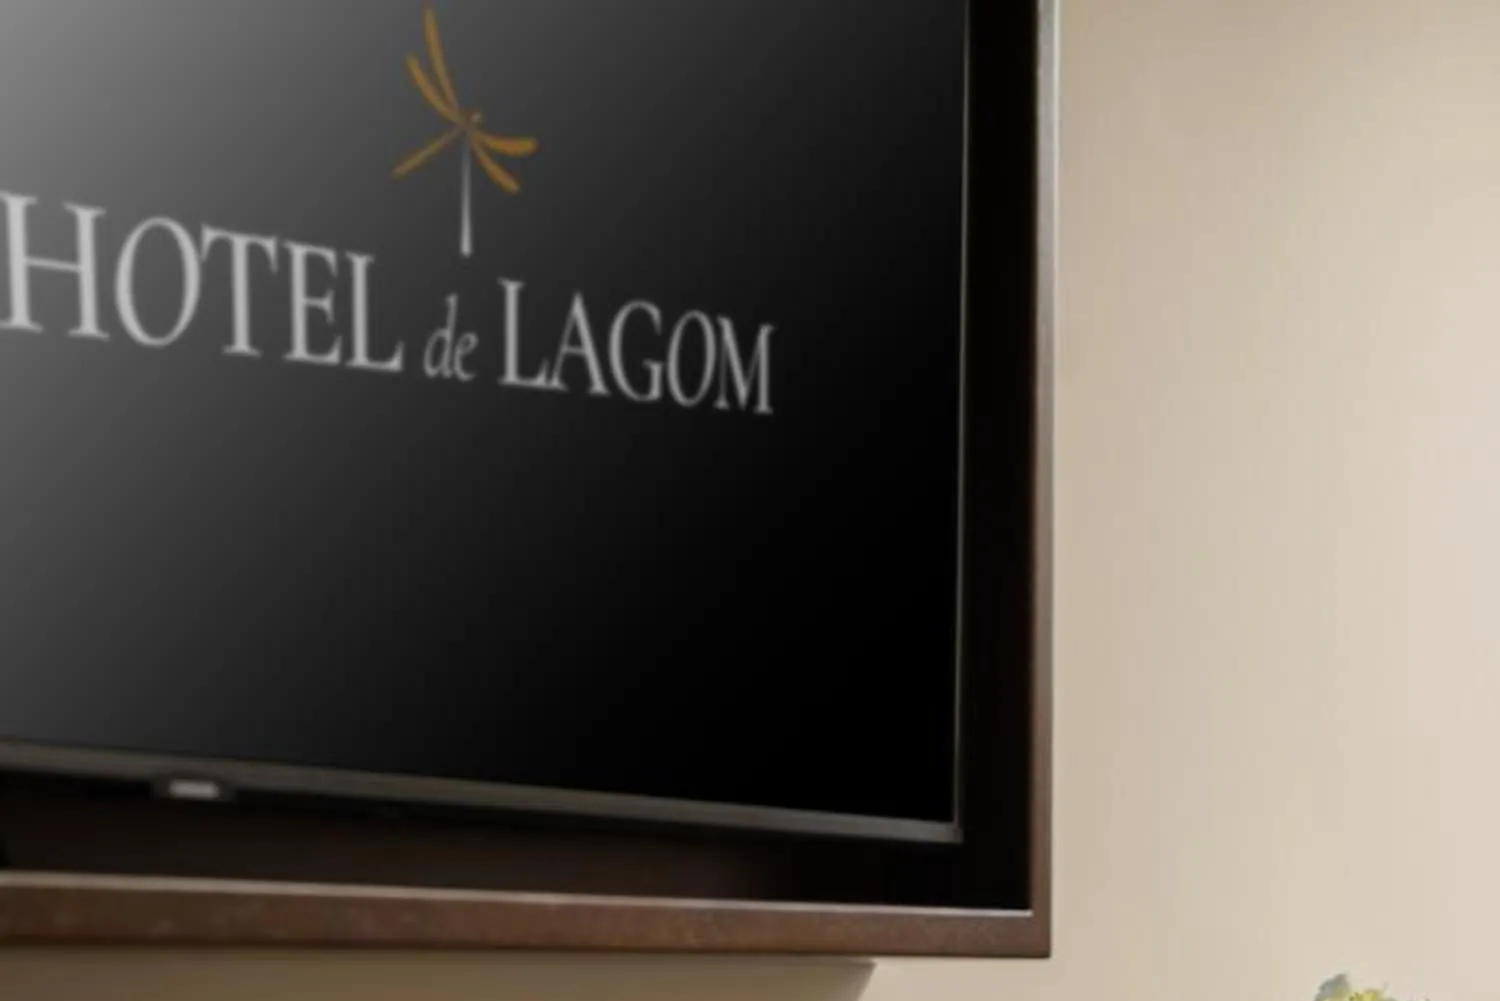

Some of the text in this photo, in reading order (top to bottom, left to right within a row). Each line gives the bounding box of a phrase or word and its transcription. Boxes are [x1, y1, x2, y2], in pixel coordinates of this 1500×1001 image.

[0, 190, 776, 415] HOTEL de LAGOM
